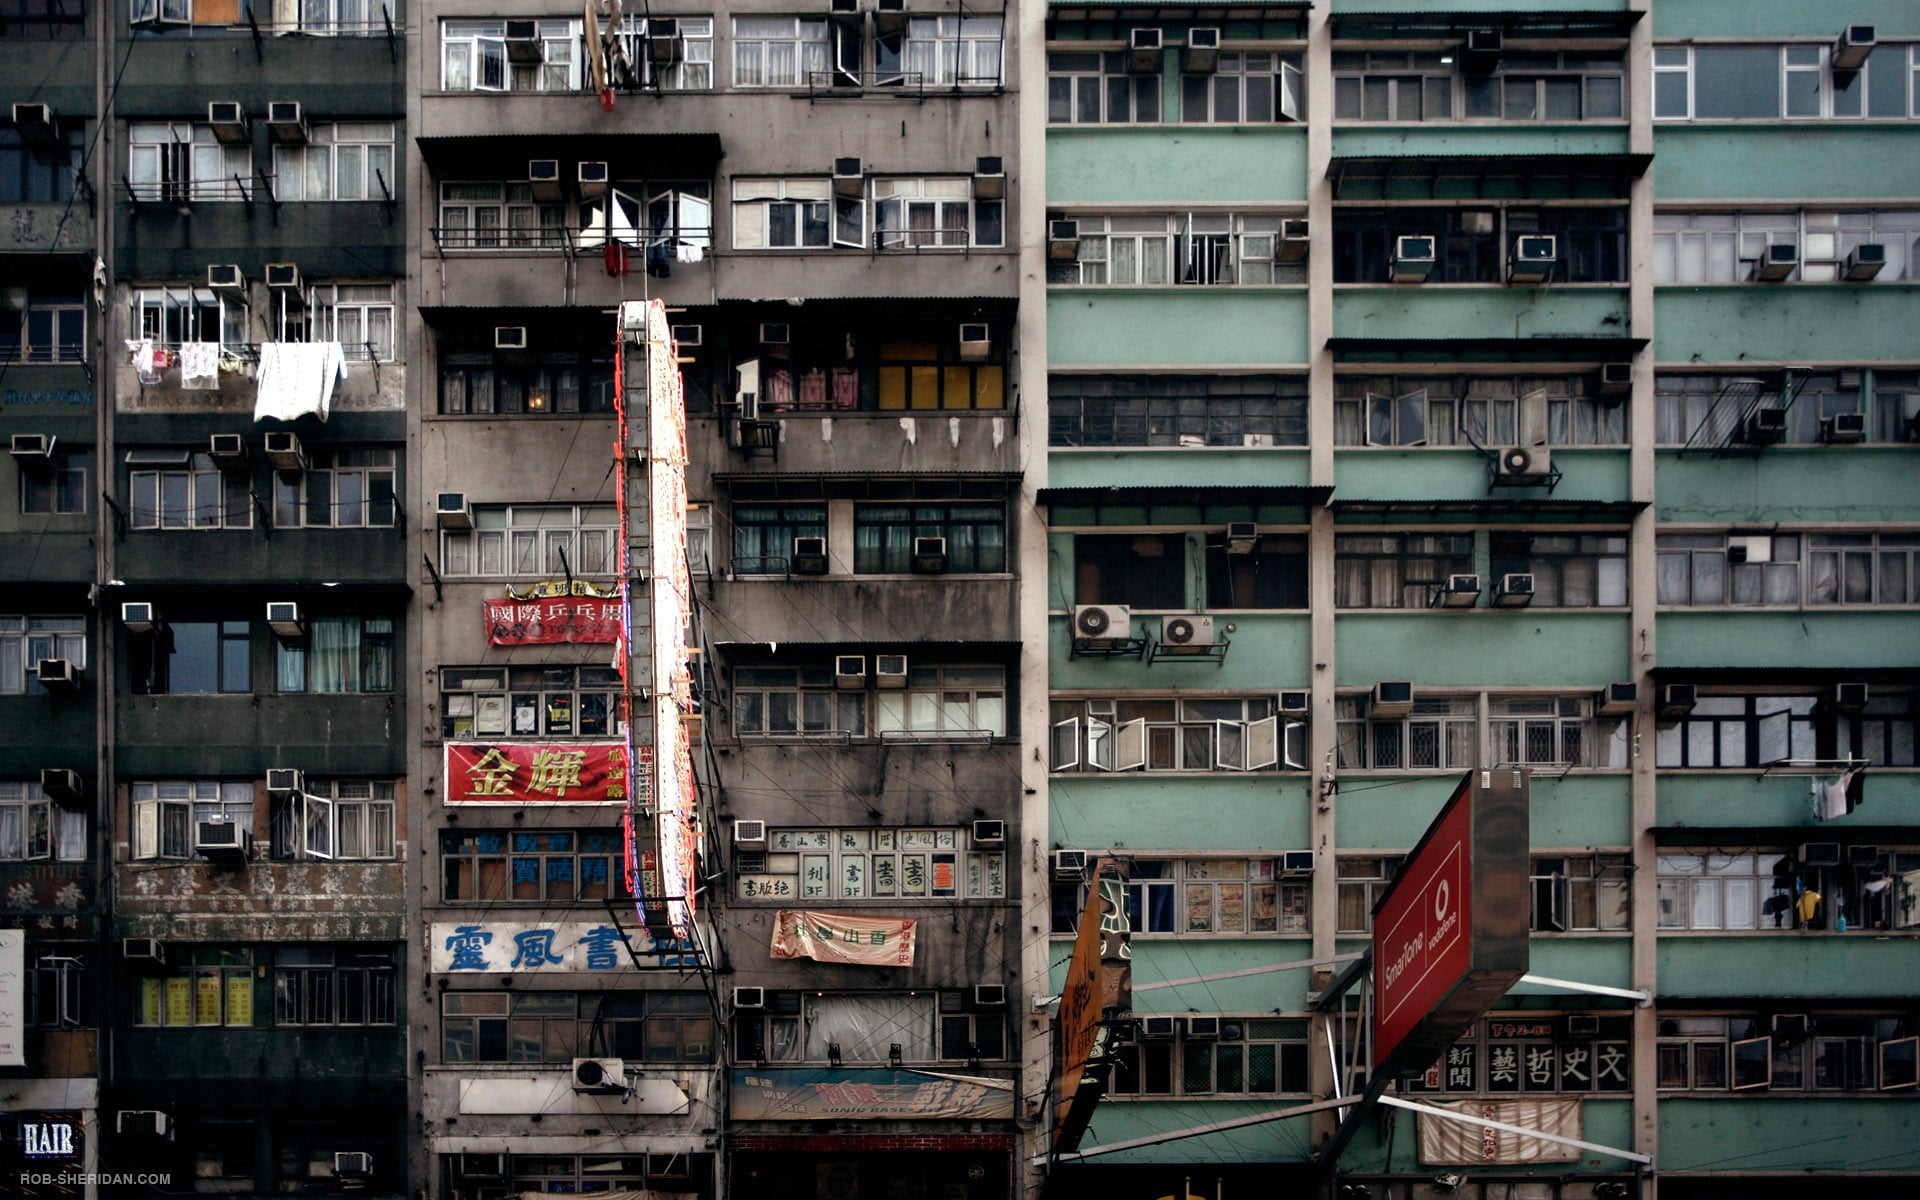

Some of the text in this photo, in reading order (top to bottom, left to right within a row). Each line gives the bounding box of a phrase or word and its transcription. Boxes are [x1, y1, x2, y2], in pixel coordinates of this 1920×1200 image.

[464, 747, 587, 798] 金輝
[807, 886, 823, 897] 3F
[845, 887, 861, 897] 3F
[1386, 911, 1457, 991] SmarTone vodafone
[24, 1123, 74, 1155] HAIR
